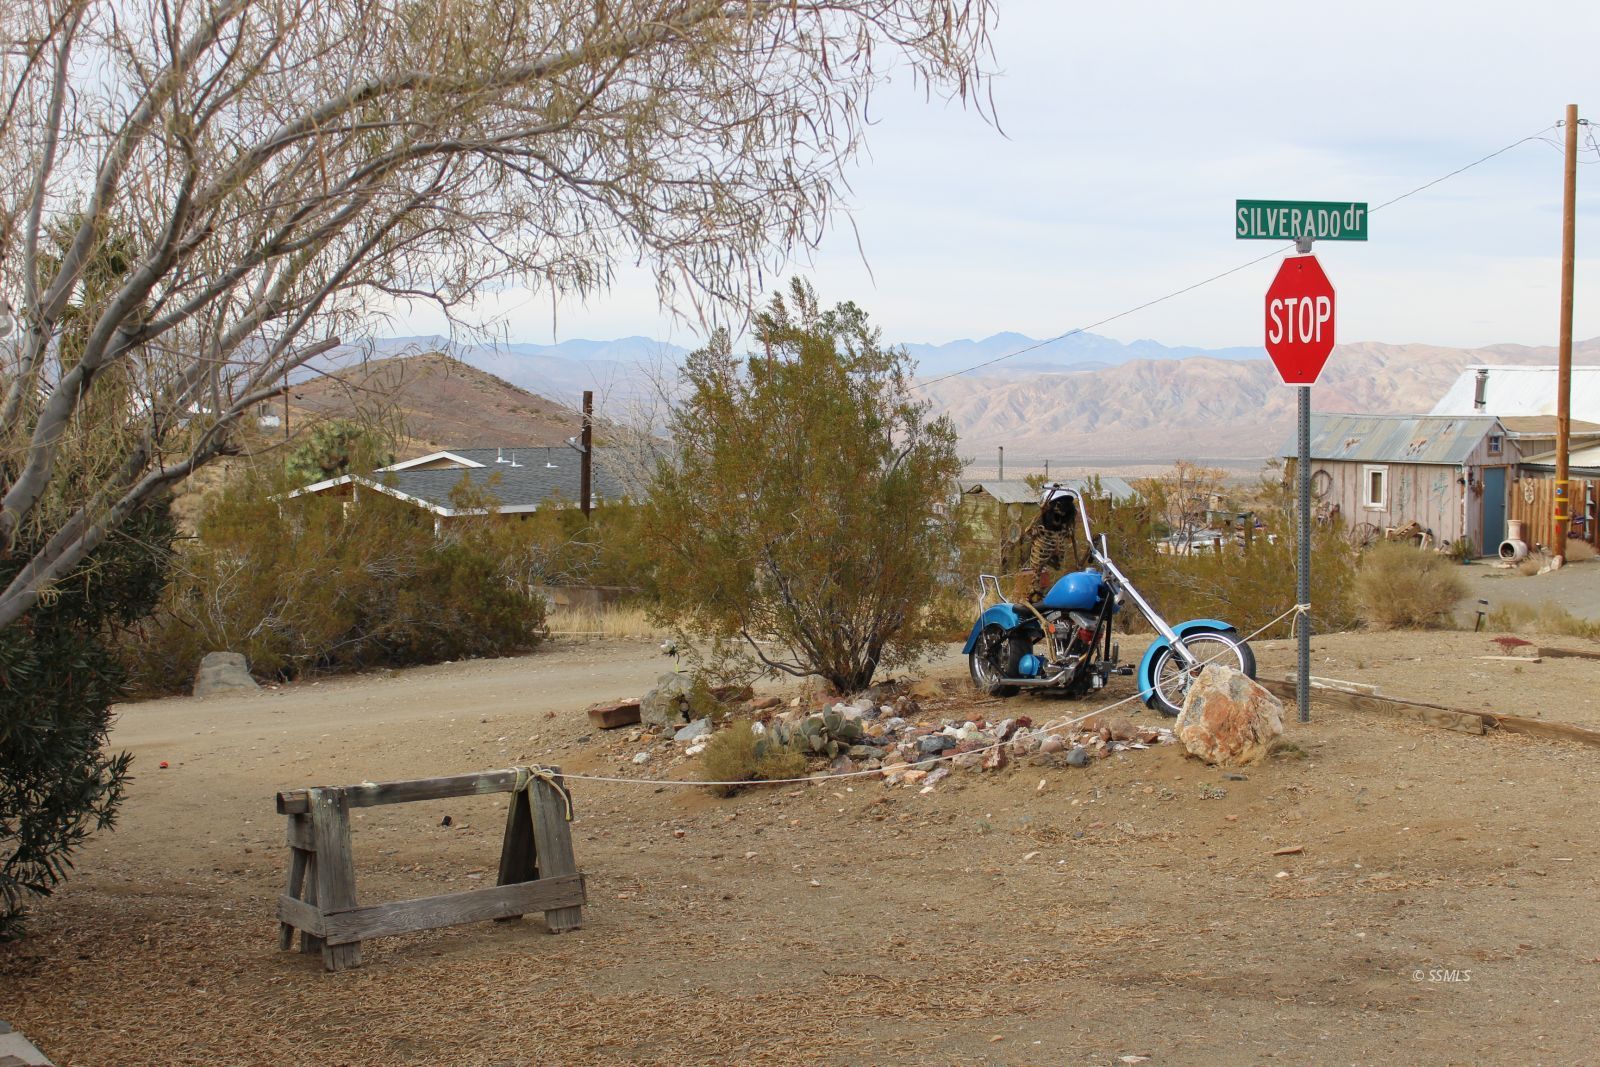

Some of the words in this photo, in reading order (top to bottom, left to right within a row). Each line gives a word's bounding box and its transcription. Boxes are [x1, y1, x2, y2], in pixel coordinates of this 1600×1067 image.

[1237, 207, 1341, 237] SILVERADO
[1344, 203, 1364, 231] dr
[1269, 295, 1331, 344] STOP
